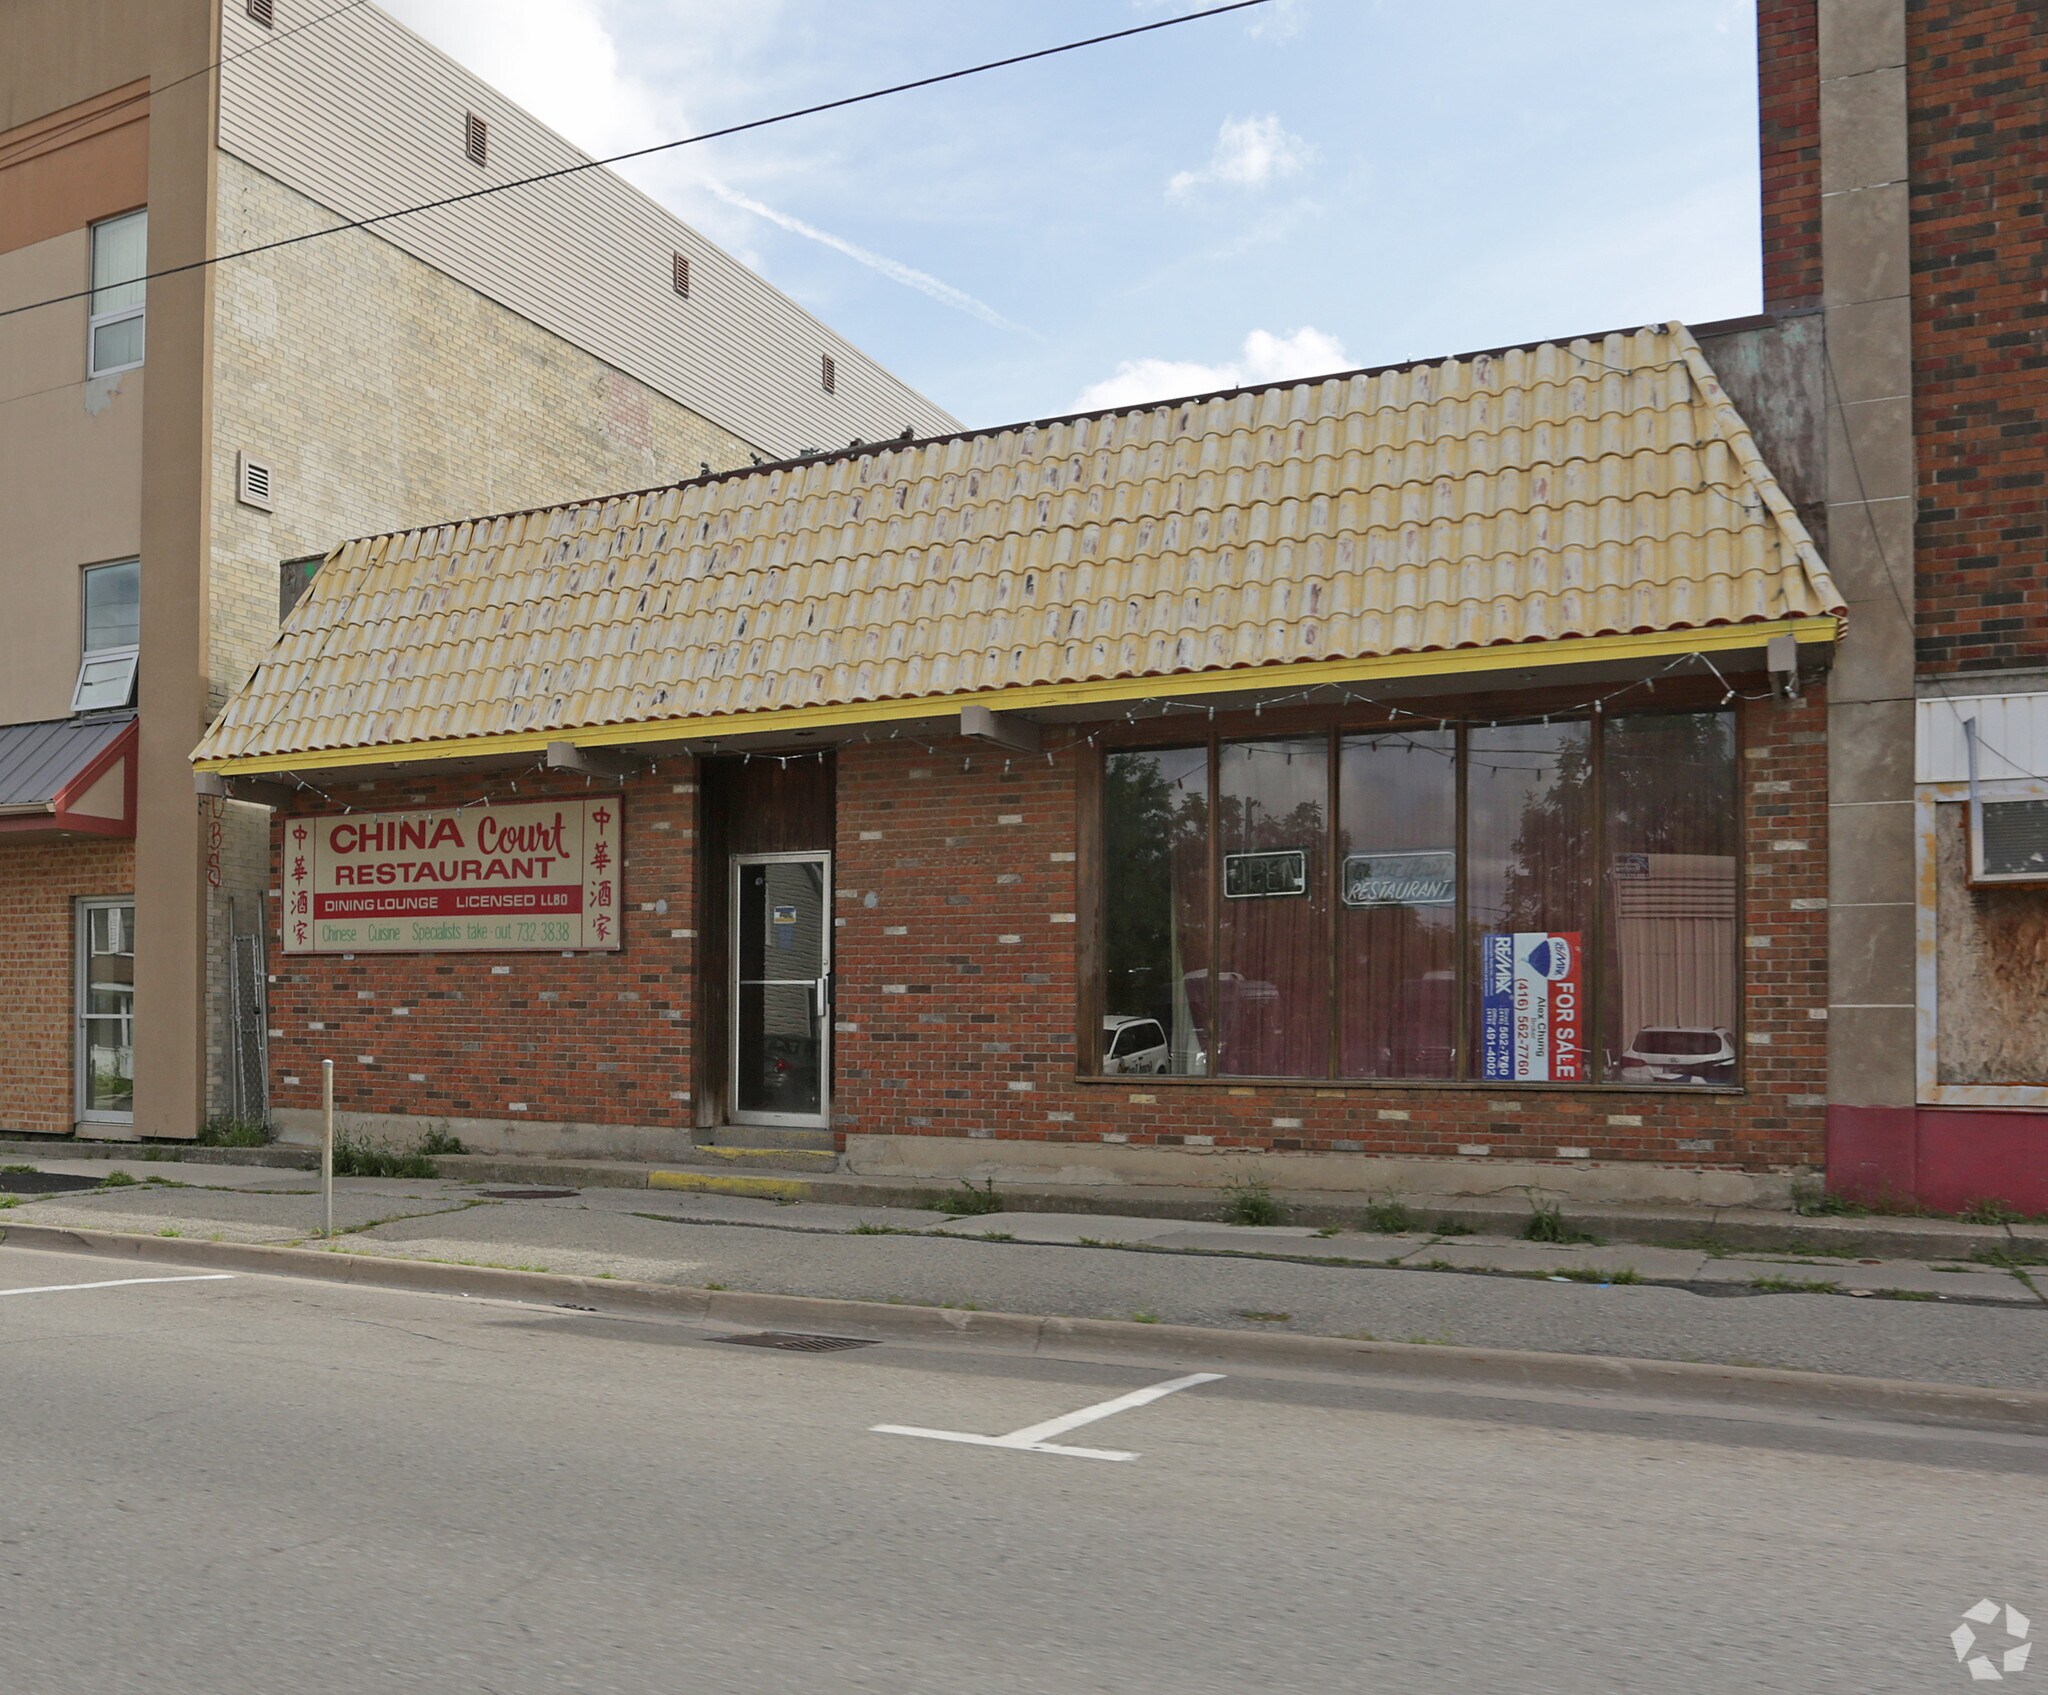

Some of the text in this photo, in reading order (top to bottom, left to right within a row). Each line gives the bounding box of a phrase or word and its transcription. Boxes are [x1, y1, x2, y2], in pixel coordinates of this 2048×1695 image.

[330, 812, 570, 859] CHINA Court
[291, 824, 308, 945] 中華酒家
[335, 857, 556, 886] RESTAURANT
[590, 806, 612, 941] 中華酒家
[1229, 857, 1301, 893] OPEN
[1350, 879, 1451, 901] RESTAURANT
[324, 893, 568, 912] DINING LOUNGE LICENSED LLBO
[322, 924, 357, 942] Chinese
[368, 923, 400, 941] Cuisine
[412, 920, 461, 945] Specialists
[1496, 937, 1512, 994] RE/MAX
[1554, 942, 1568, 976] RE/MAX
[1515, 978, 1529, 1076] (416) 562-7760
[1536, 996, 1547, 1057] Alex Chung
[1556, 982, 1575, 1077] FOR SALE
[1487, 1026, 1497, 1076] 491-4002
